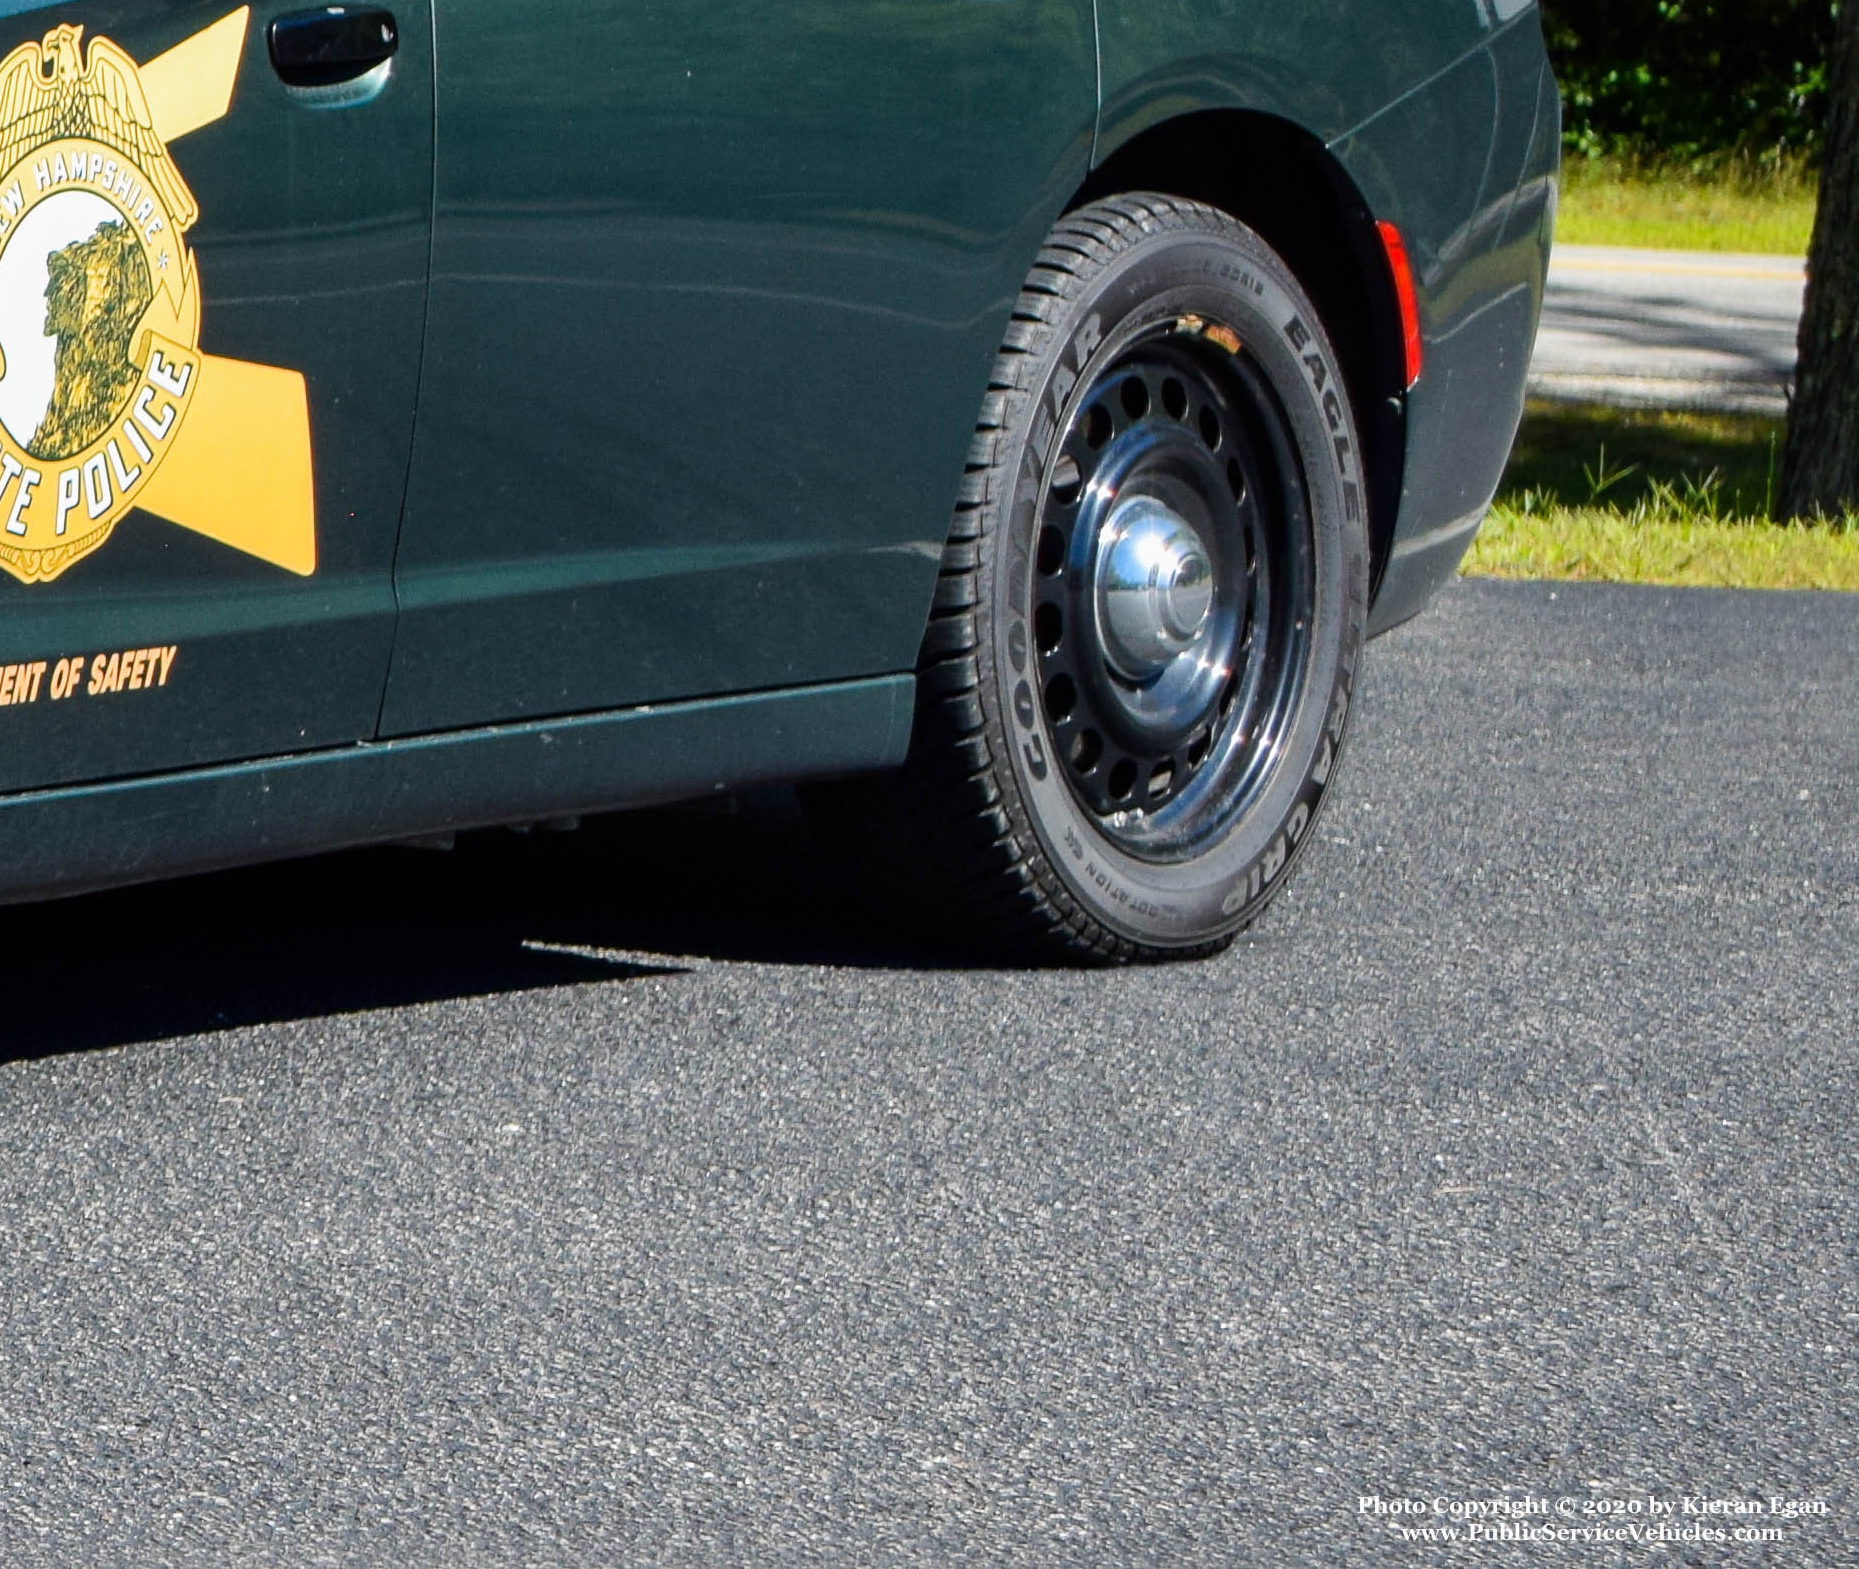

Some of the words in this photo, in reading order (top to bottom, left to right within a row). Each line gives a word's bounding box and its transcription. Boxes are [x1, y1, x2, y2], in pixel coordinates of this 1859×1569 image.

[33, 150, 164, 246] HAMPSHIRE
[55, 350, 192, 535] POLICE
[1283, 315, 1361, 524] EAGLE
[50, 656, 85, 701] OF
[87, 645, 178, 696] SAFETY
[1222, 802, 1309, 915] GRIP
